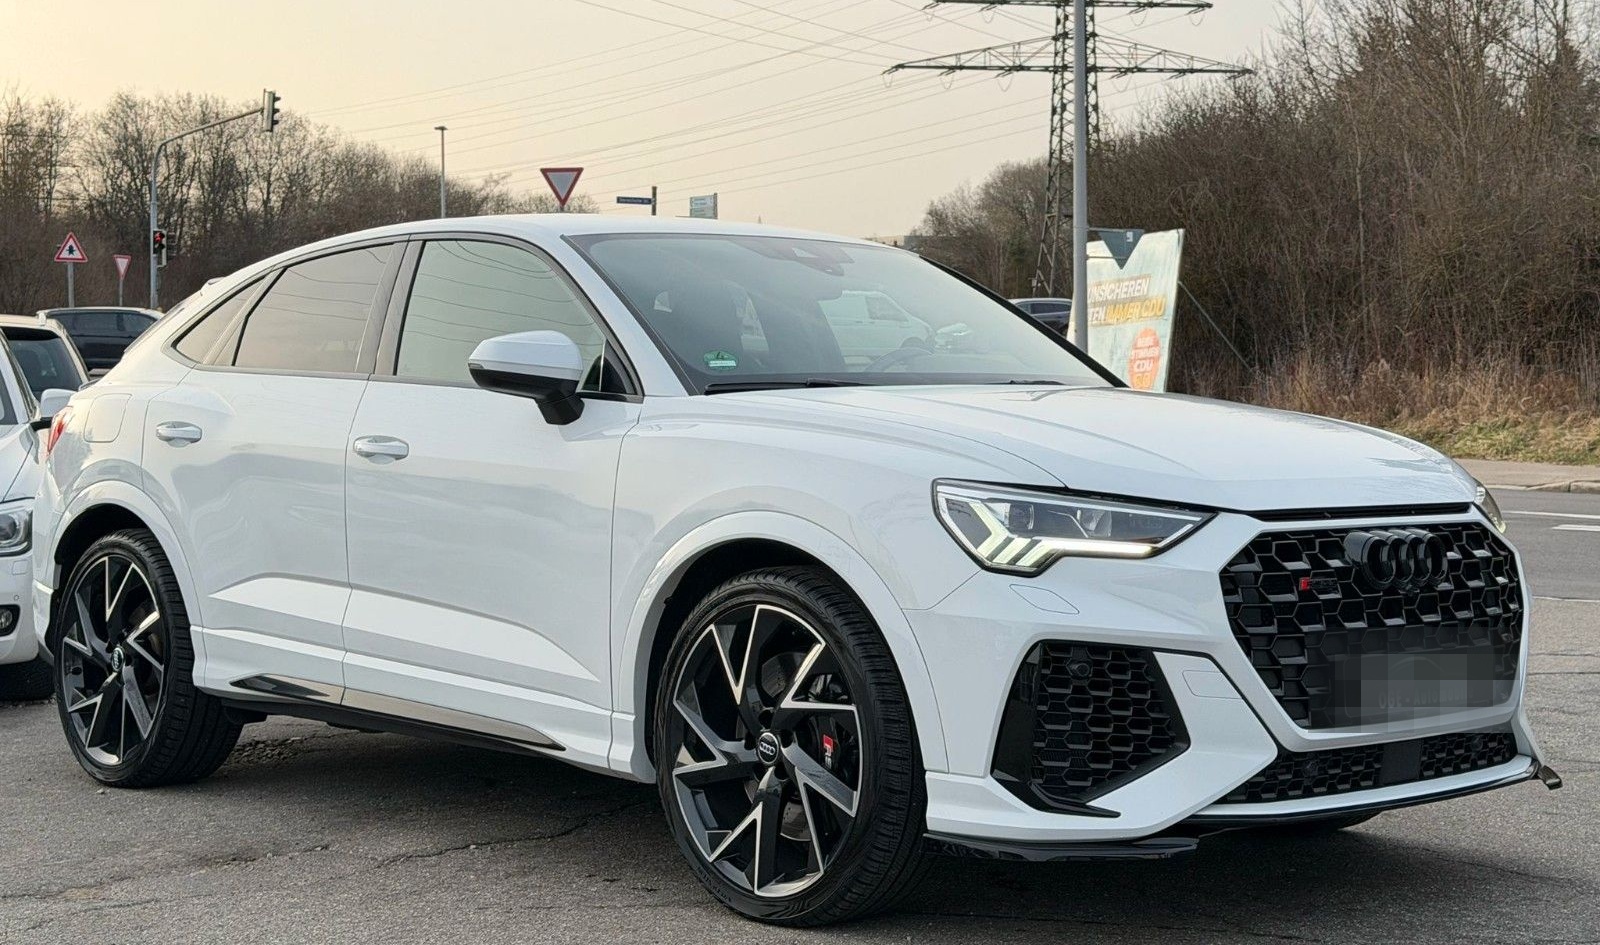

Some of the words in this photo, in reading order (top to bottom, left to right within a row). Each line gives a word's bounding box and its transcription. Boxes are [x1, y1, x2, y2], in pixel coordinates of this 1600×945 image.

[1088, 277, 1150, 302] UNSICHEREN
[1142, 297, 1166, 317] CDU
[1133, 360, 1153, 372] CDU
